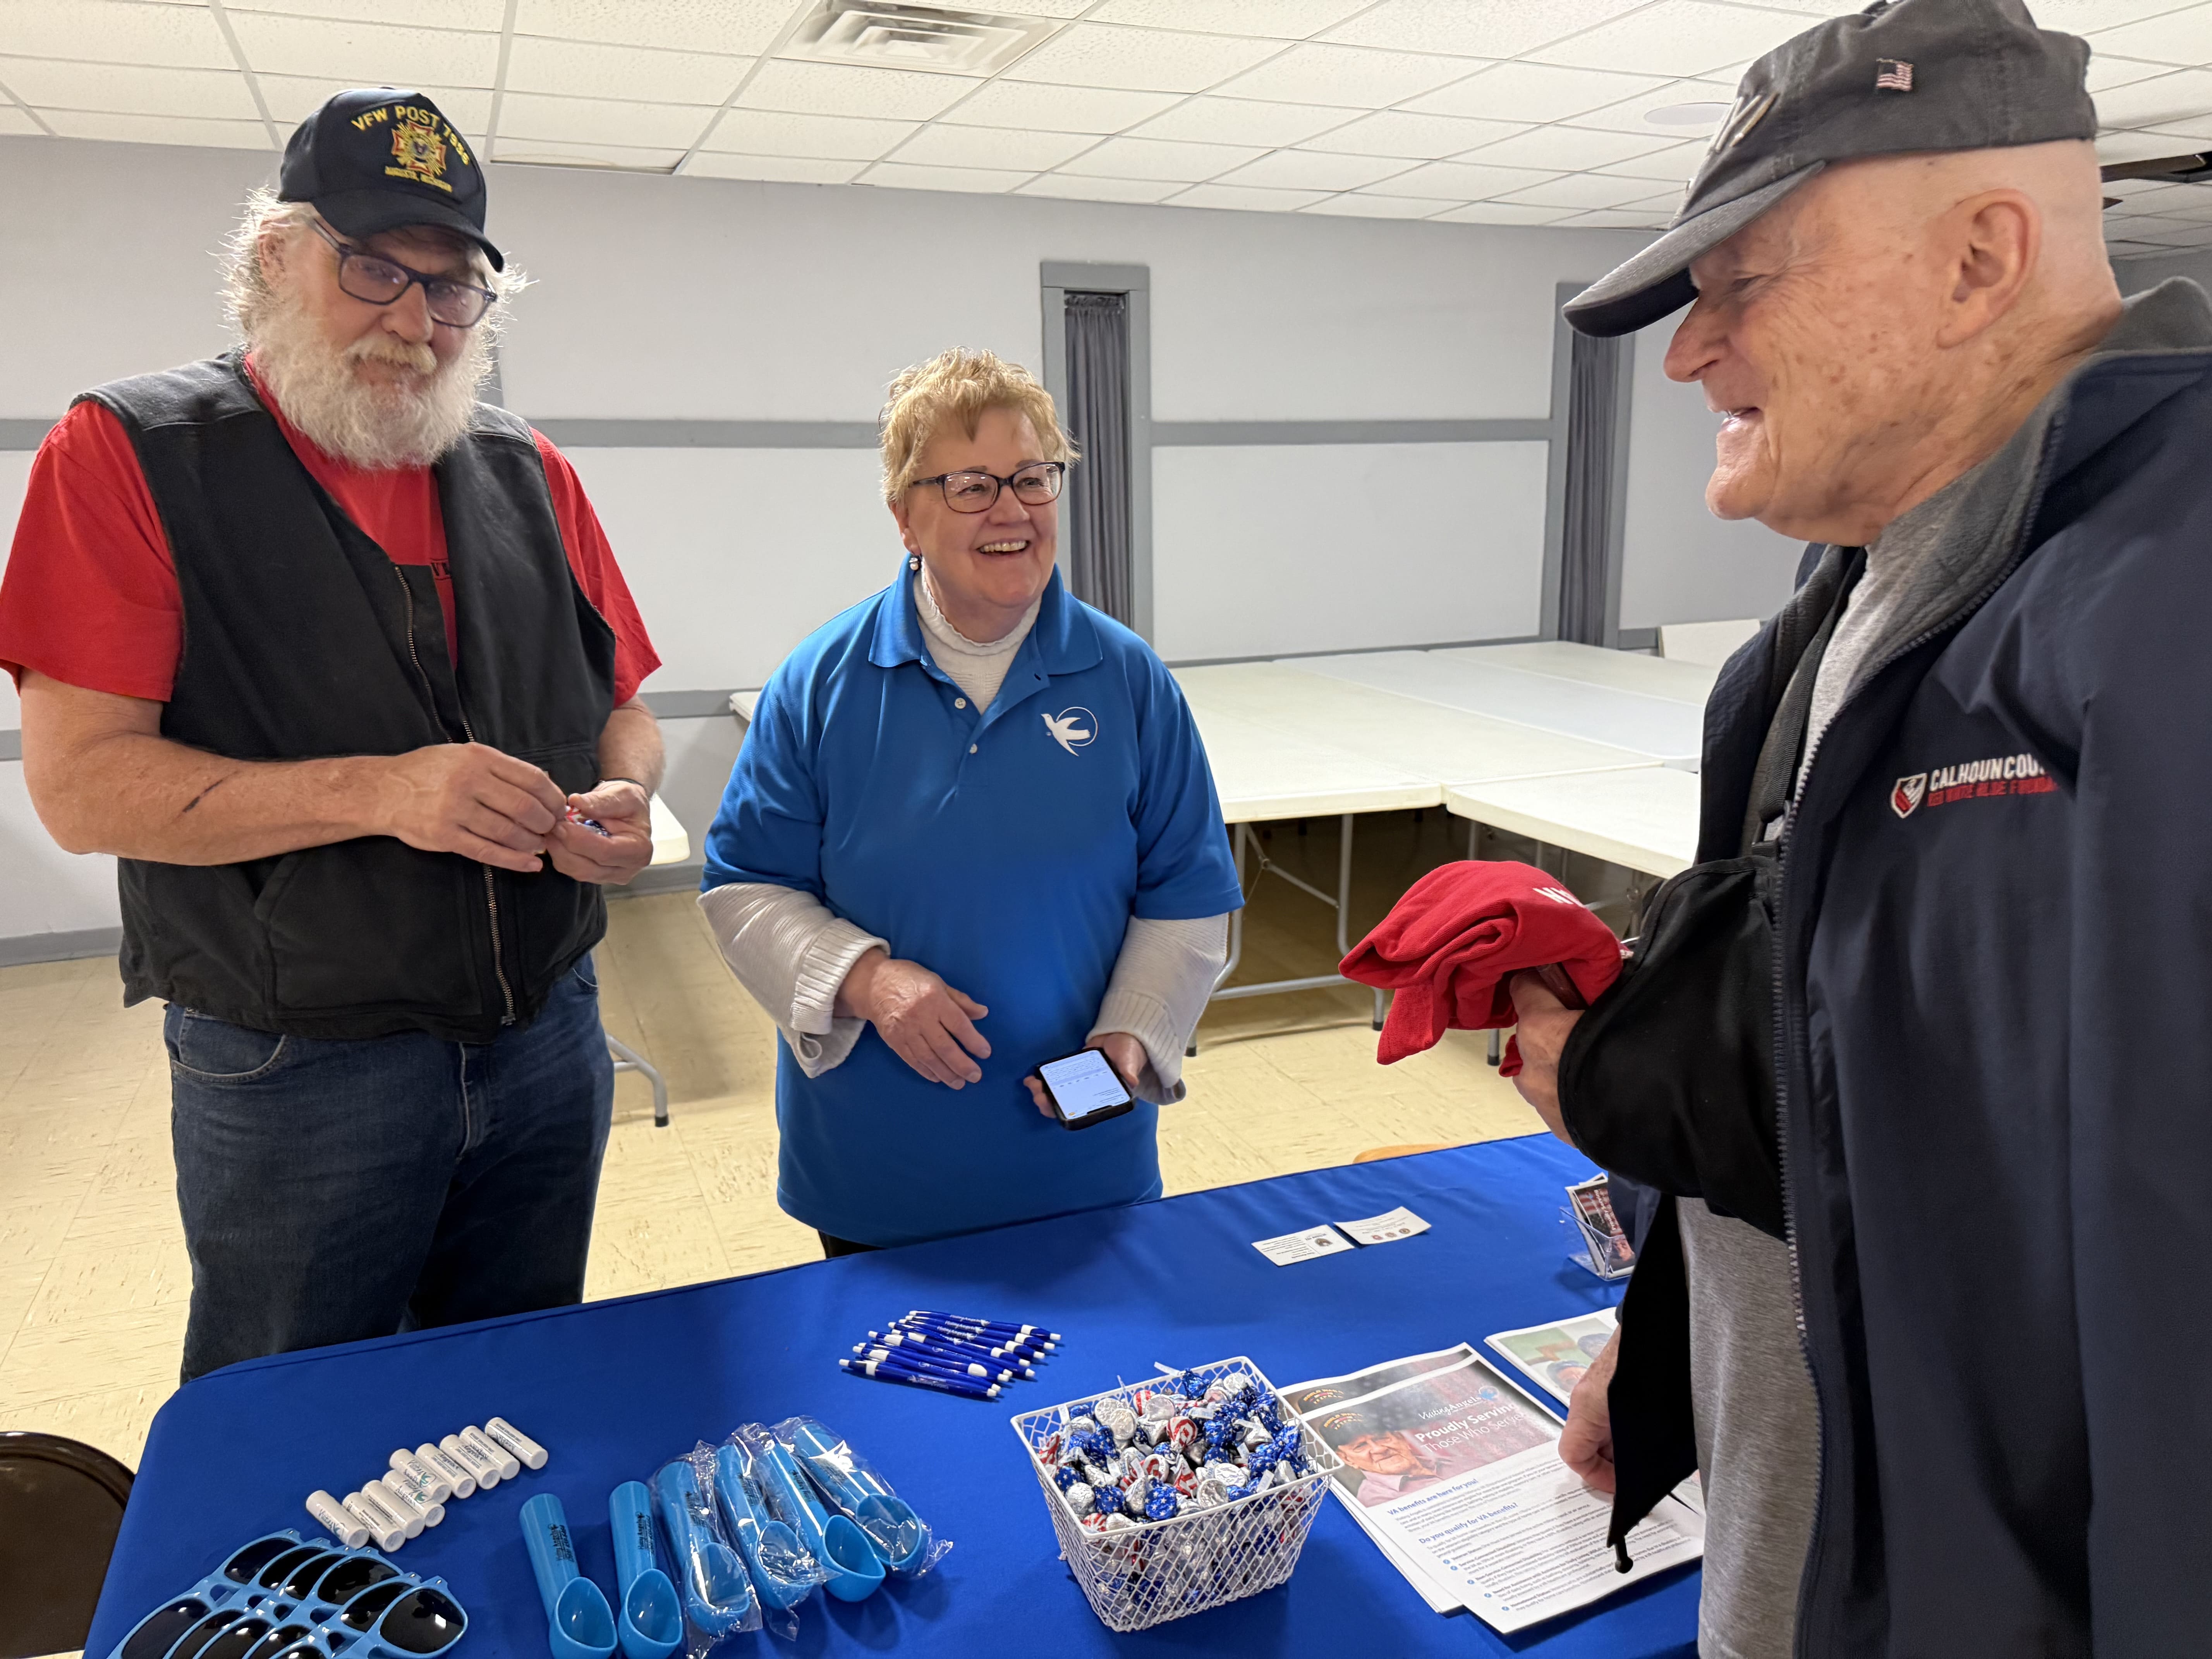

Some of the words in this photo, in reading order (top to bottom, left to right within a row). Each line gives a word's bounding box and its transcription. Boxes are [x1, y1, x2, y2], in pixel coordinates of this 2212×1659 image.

[351, 108, 388, 131] VFW
[394, 105, 440, 129] POST
[1929, 757, 2003, 791] CALHOUN
[2003, 753, 2045, 780] COU
[1414, 1420, 1469, 1443] Proudly
[1467, 1402, 1520, 1425] Serving
[1420, 1436, 1462, 1453] Those
[1457, 1425, 1490, 1441] Who
[1398, 1499, 1426, 1512] benefits
[1436, 1488, 1454, 1497] here
[1463, 1479, 1479, 1488] you!
[1430, 1532, 1445, 1540] you
[1444, 1522, 1468, 1534] qualify
[1487, 1502, 1519, 1517] benefits?
